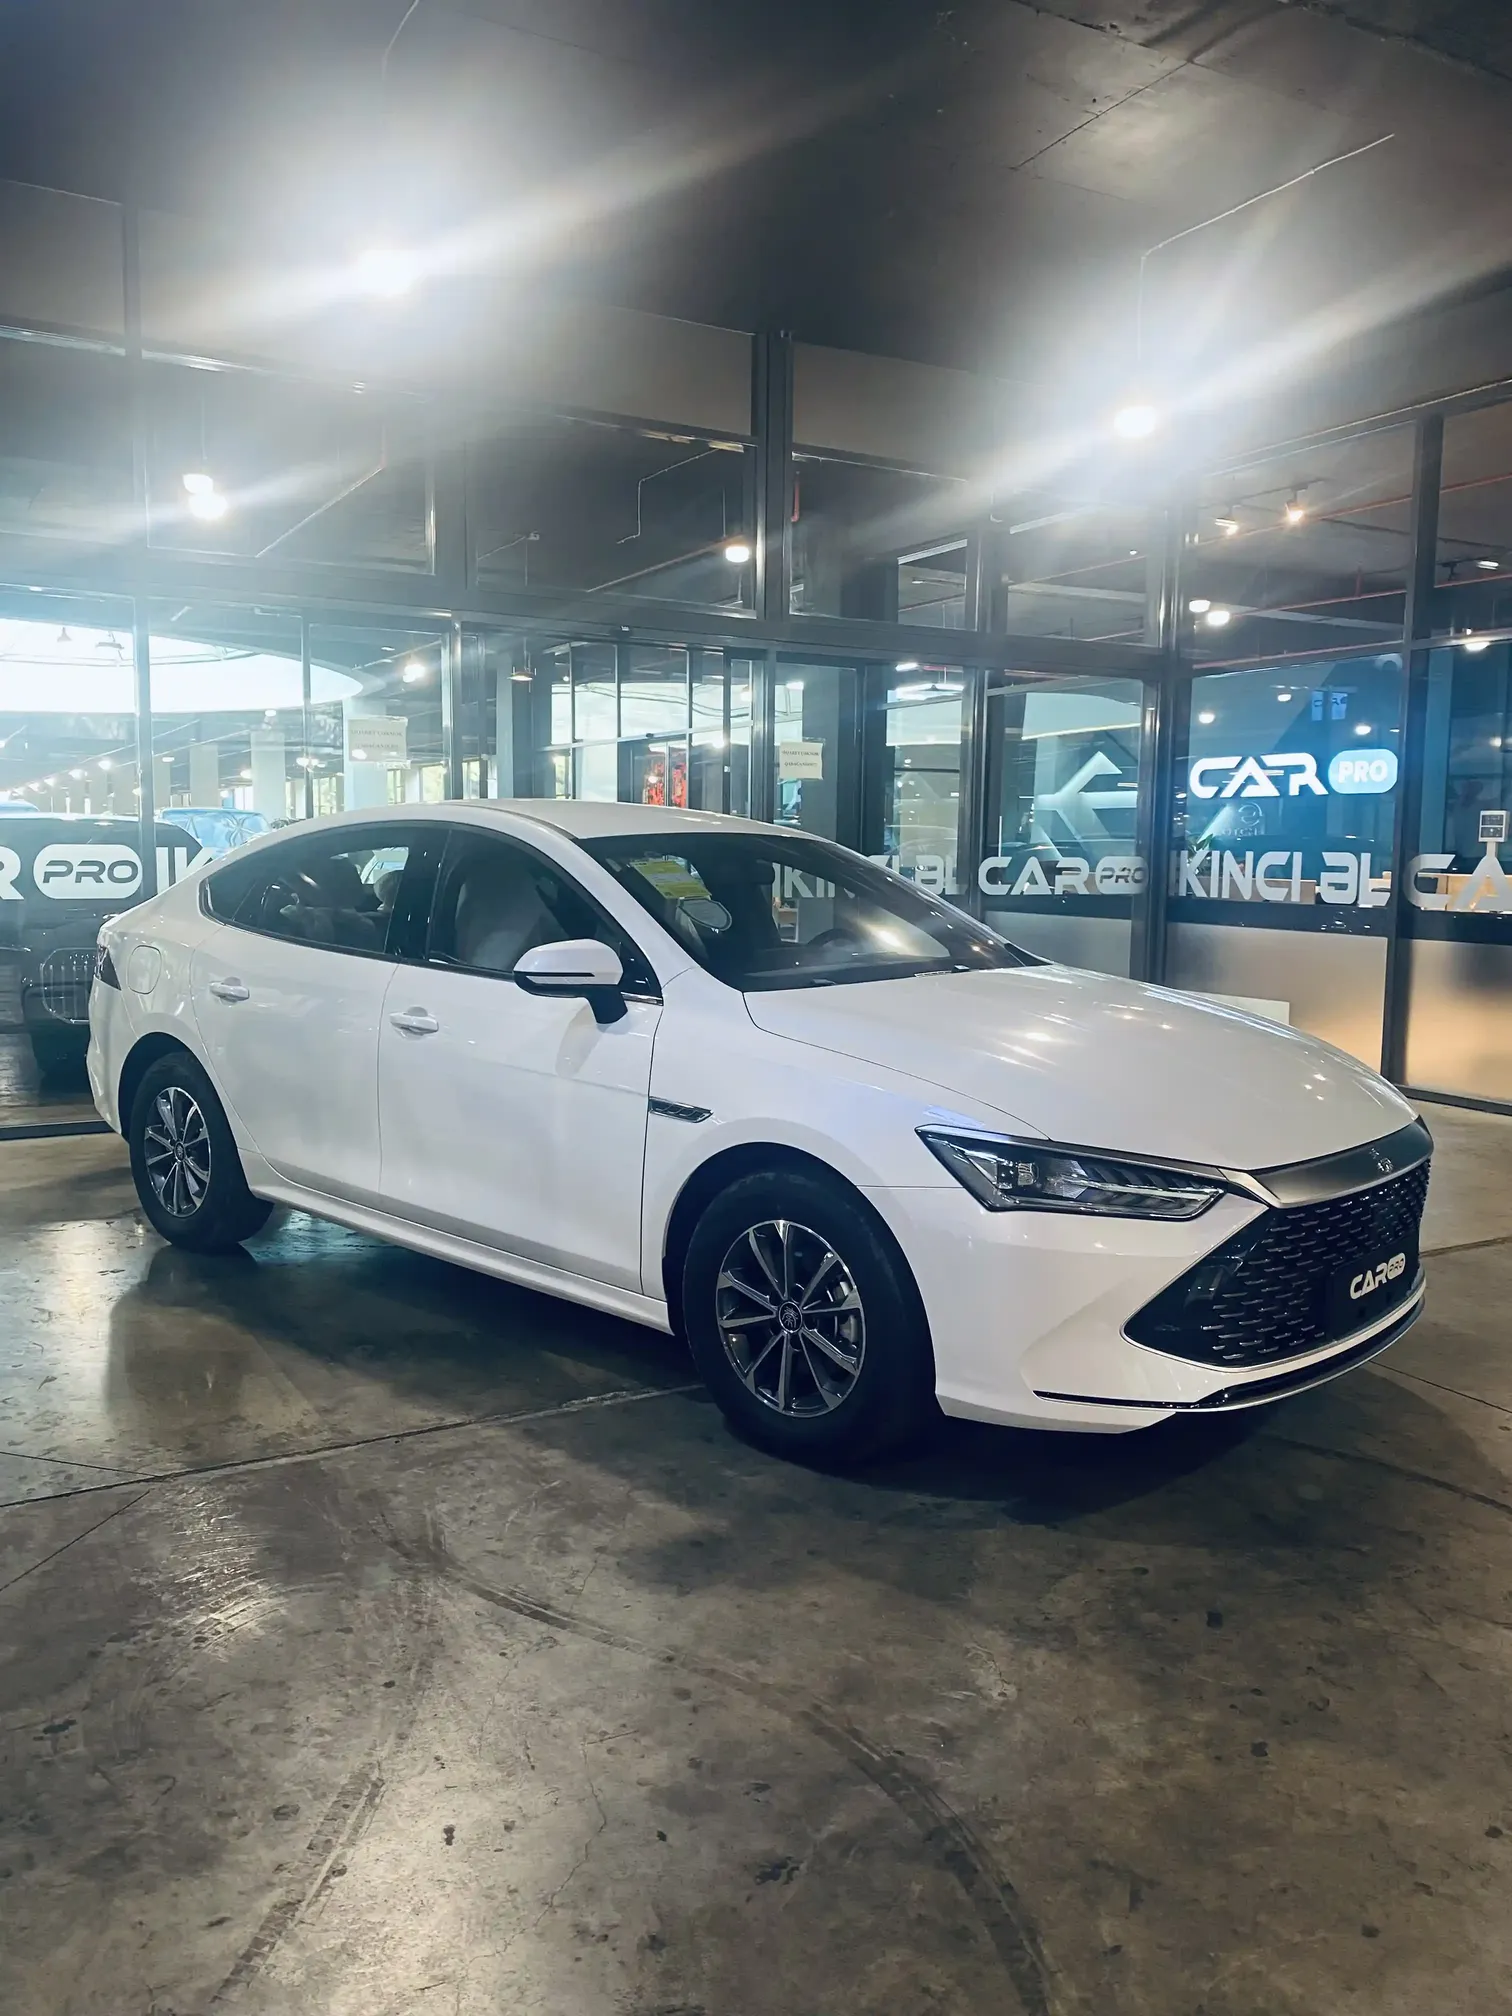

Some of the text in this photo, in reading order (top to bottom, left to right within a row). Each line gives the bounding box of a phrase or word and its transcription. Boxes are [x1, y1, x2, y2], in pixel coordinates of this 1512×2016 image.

[1190, 752, 1388, 798] CAR PRO
[42, 860, 139, 884] PRO
[978, 856, 1090, 895] CAR
[1099, 867, 1146, 884] PRO
[1350, 1262, 1387, 1299] CAR
